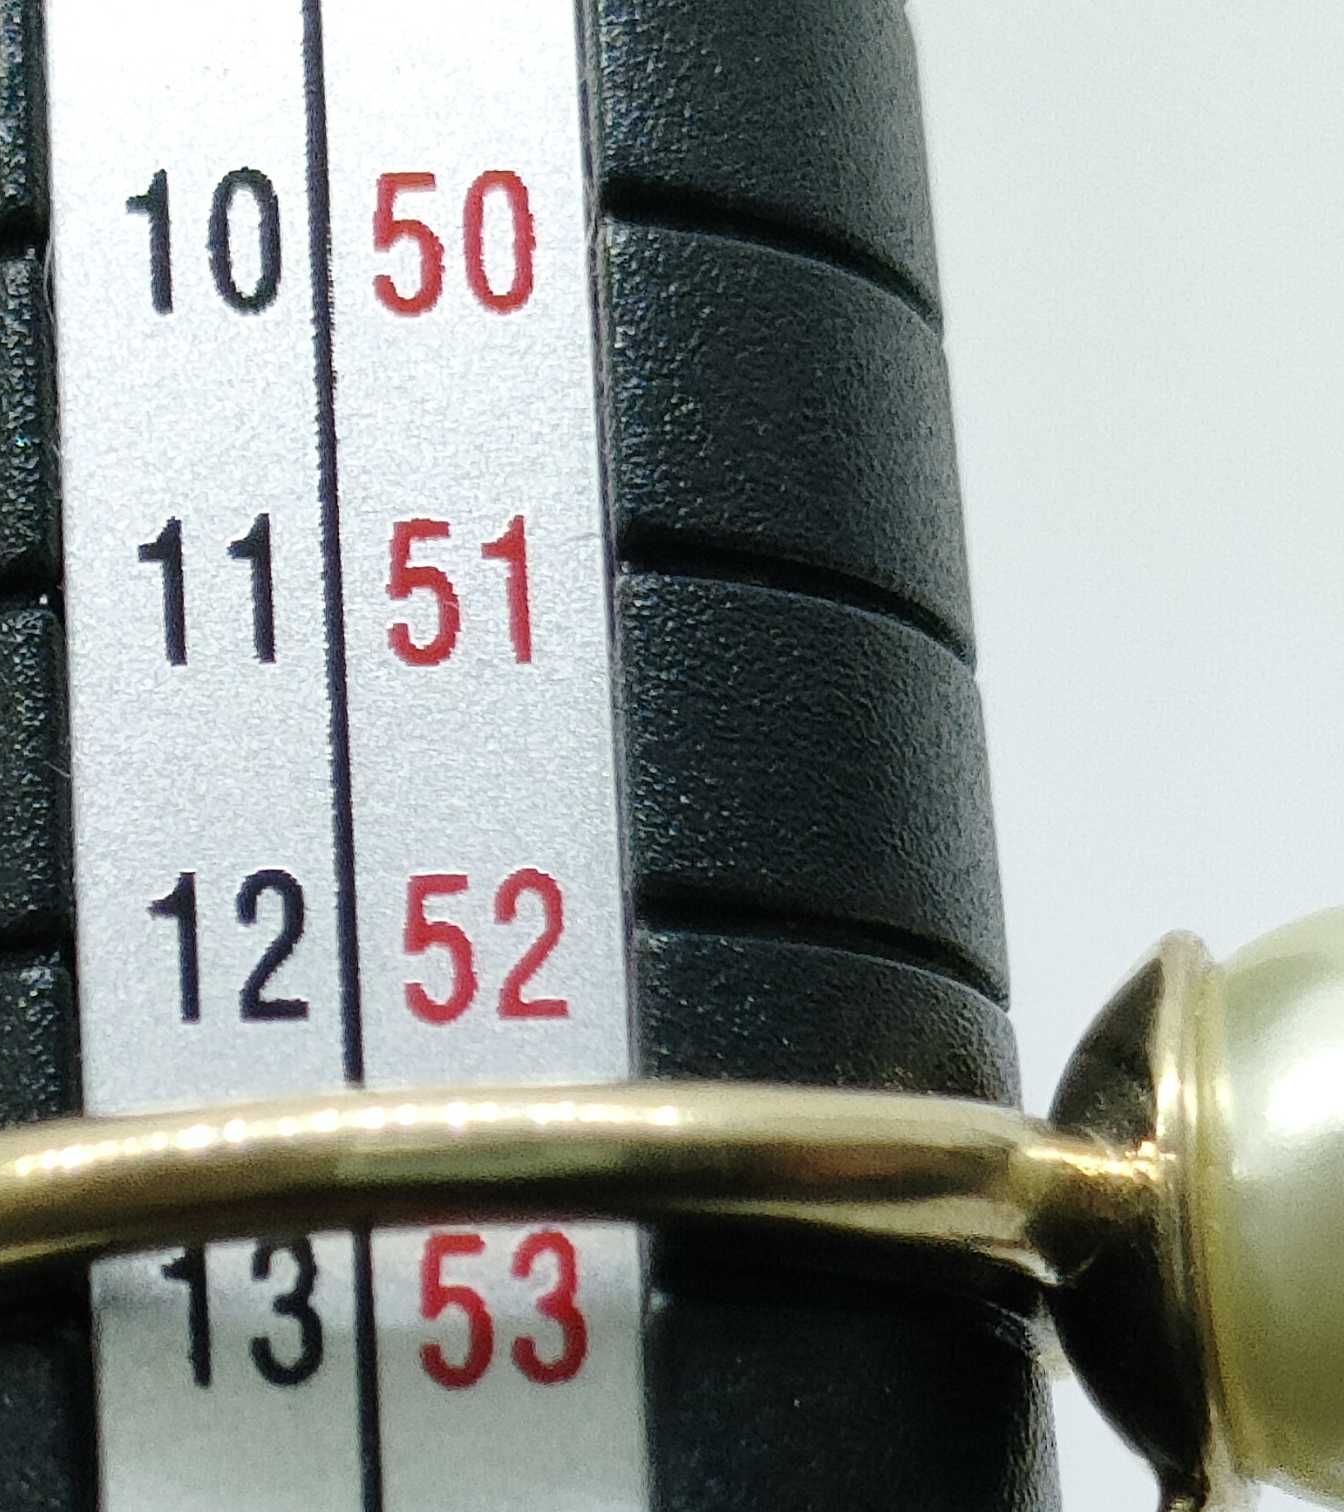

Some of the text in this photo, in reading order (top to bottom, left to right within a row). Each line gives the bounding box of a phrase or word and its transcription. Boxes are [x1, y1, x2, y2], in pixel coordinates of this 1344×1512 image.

[127, 167, 536, 315] 10 50
[139, 514, 532, 665] 11 51
[149, 869, 568, 1024] 12 52
[161, 1232, 586, 1387] 13 53
